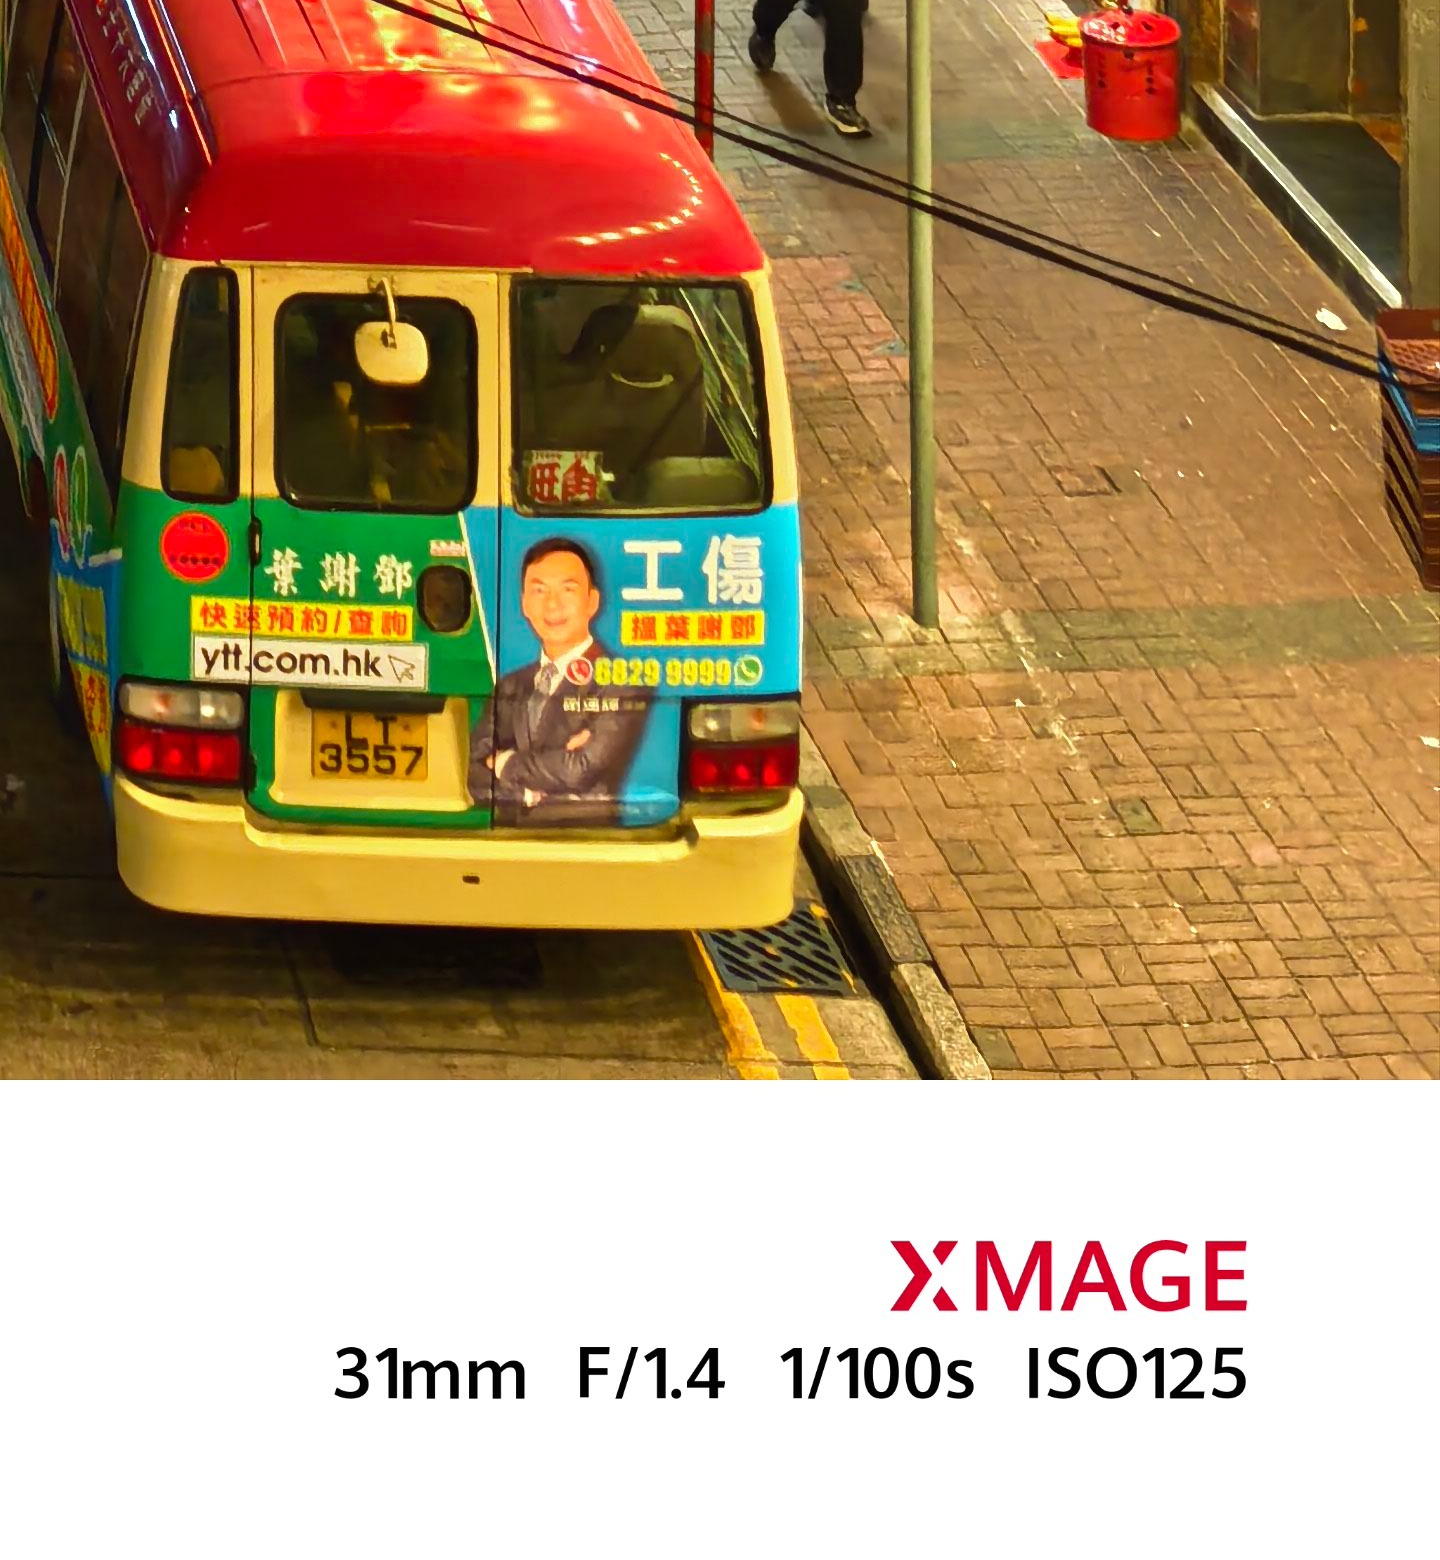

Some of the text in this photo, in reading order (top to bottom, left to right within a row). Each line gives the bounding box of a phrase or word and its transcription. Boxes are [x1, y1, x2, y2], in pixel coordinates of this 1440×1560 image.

[264, 547, 413, 599] 葉謝鄧
[621, 534, 763, 605] 工傷
[199, 601, 409, 636] 快速預約/查詢
[201, 643, 383, 678] ytt.com.hk
[595, 658, 732, 687] 6829 9999
[345, 715, 398, 748] LT
[319, 743, 423, 775] 3557
